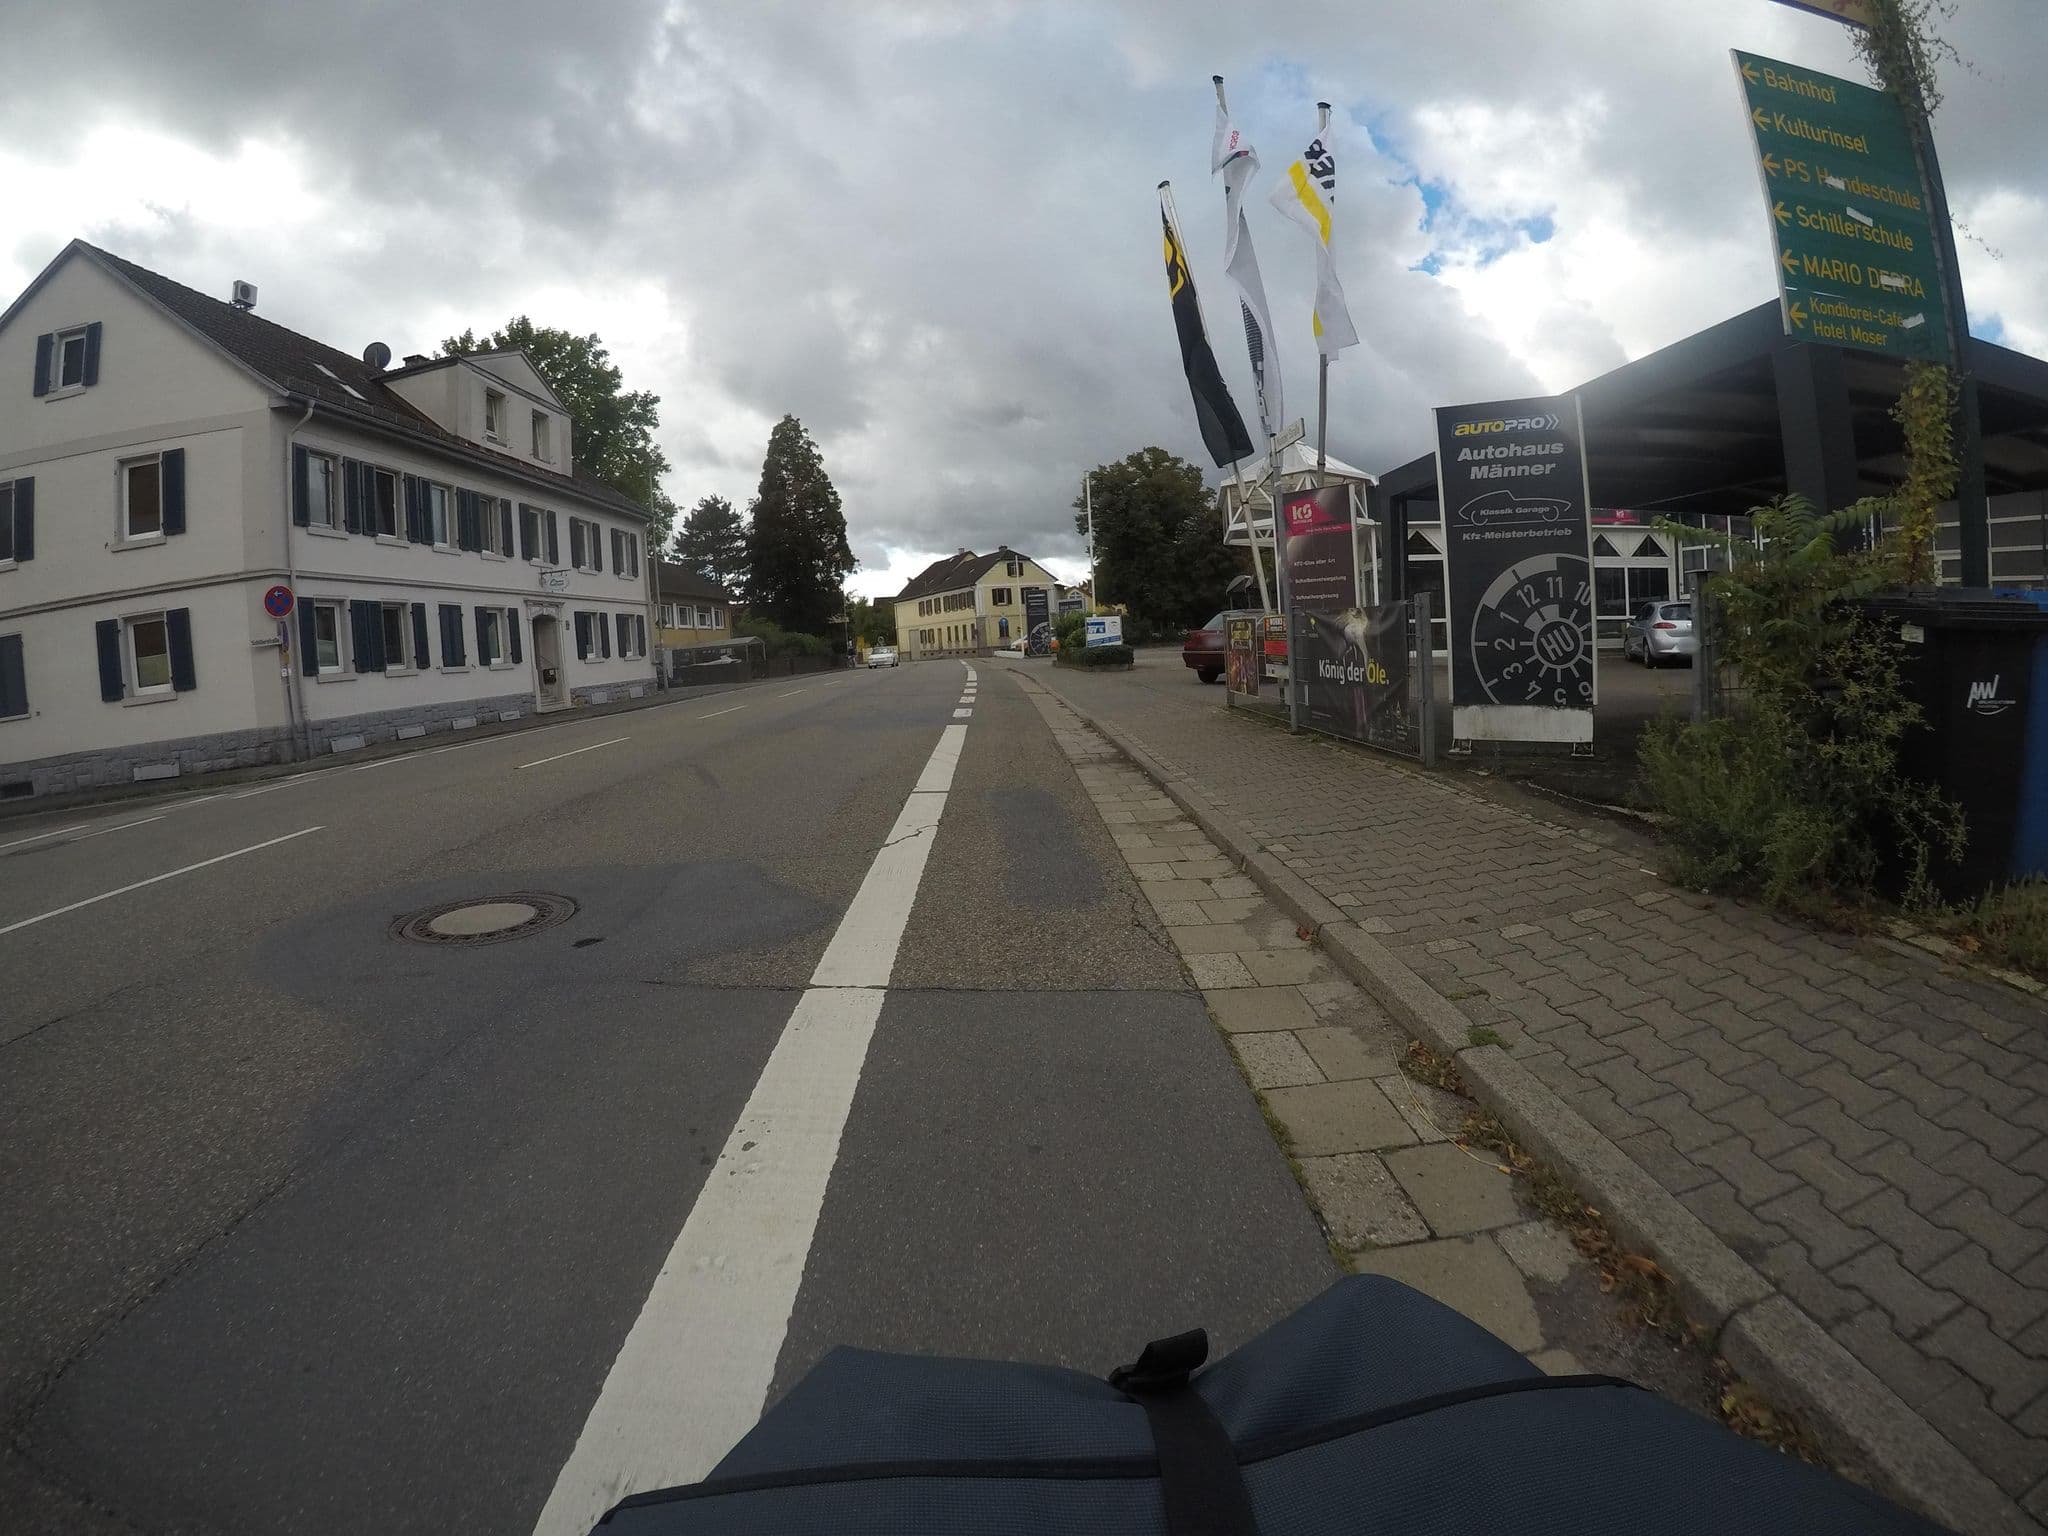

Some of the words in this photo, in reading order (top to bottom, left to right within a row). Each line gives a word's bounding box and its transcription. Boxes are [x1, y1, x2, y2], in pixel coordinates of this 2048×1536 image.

[1763, 68, 1836, 104] Bahnhof
[1774, 112, 1869, 154] Kulturinsel
[1784, 158, 1811, 183] PS
[1796, 205, 1914, 252] Schillerschule
[1803, 254, 1862, 286] MARIO
[1813, 320, 1848, 341] Hotel
[1851, 327, 1888, 347] Moser
[1457, 442, 1564, 461] Autohaus
[1470, 463, 1557, 480] Männer
[1480, 508, 1513, 516] Klassik
[1516, 506, 1550, 515] Garage
[1462, 527, 1573, 541] Kfz-Meisterbetrieb
[1516, 584, 1541, 608] 12
[1546, 576, 1563, 599] 11
[1500, 611, 1520, 624] 1
[1494, 638, 1516, 651] 2
[1540, 624, 1575, 661] HU
[1319, 659, 1345, 684] König
[1347, 662, 1364, 682] der
[1367, 658, 1389, 685] Öle.
[1502, 662, 1523, 680] 3
[1524, 680, 1543, 701] 4
[1553, 687, 1567, 705] 5
